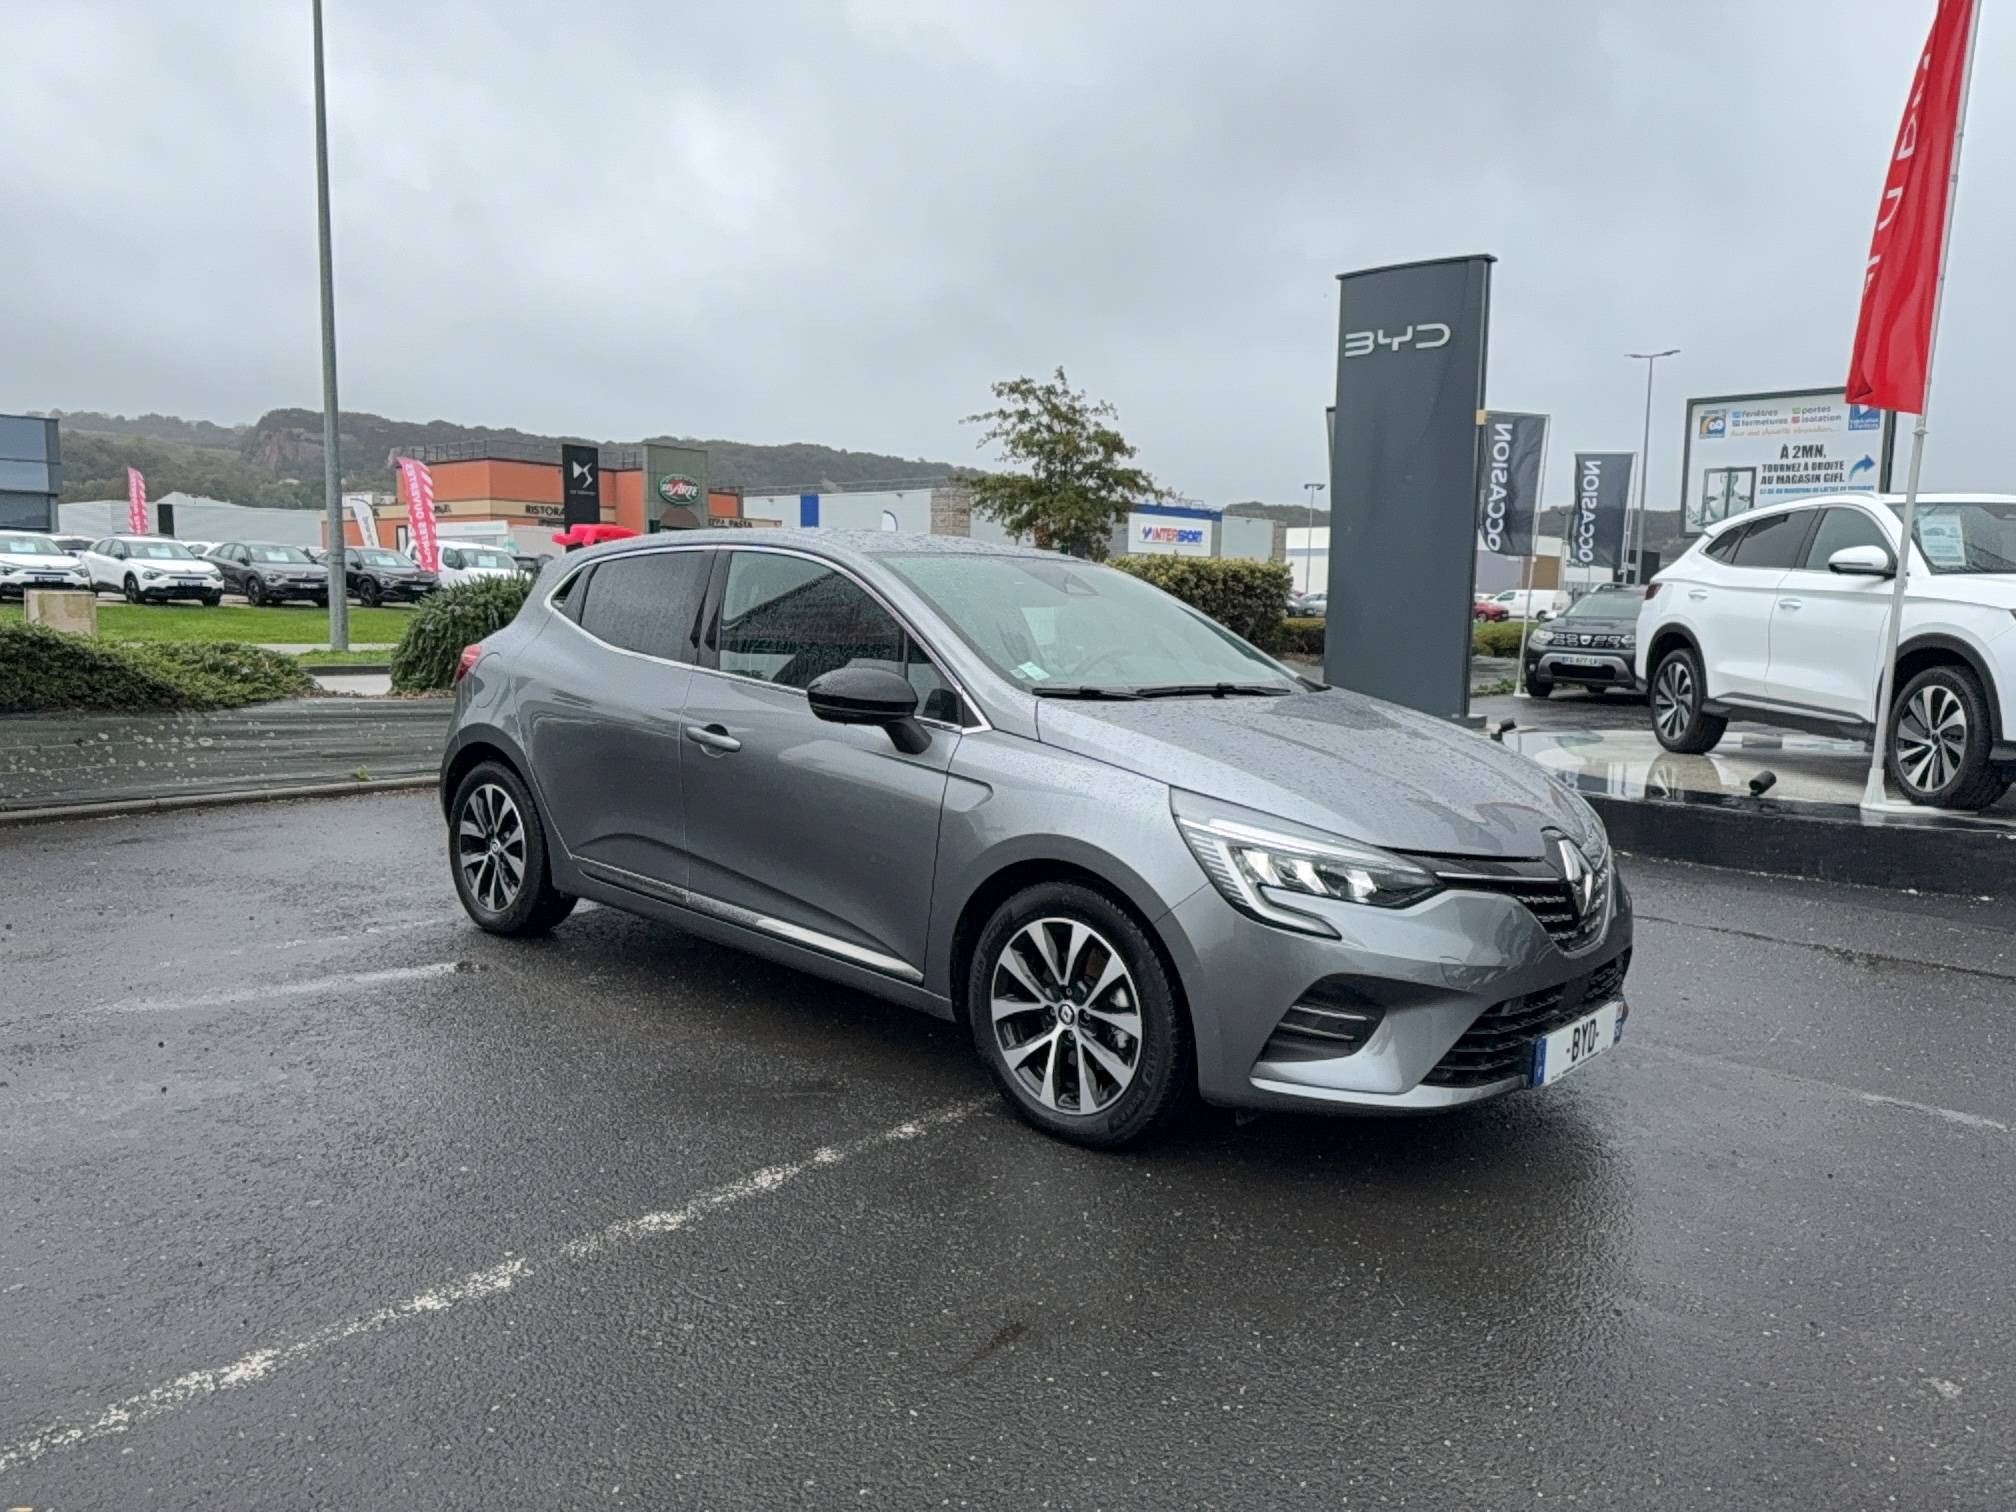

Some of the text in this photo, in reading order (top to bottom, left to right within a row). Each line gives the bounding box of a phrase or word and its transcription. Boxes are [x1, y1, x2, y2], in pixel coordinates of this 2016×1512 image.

[1344, 322, 1451, 358] BYD
[1780, 443, 1789, 459] À
[1762, 463, 1801, 473] TOURNEZ
[1811, 460, 1845, 471] DROITE
[1760, 475, 1774, 485] AU
[1776, 474, 1820, 484] MAGASIN
[1152, 527, 1203, 542] INTERSPORT
[1571, 1018, 1598, 1062] BYD
